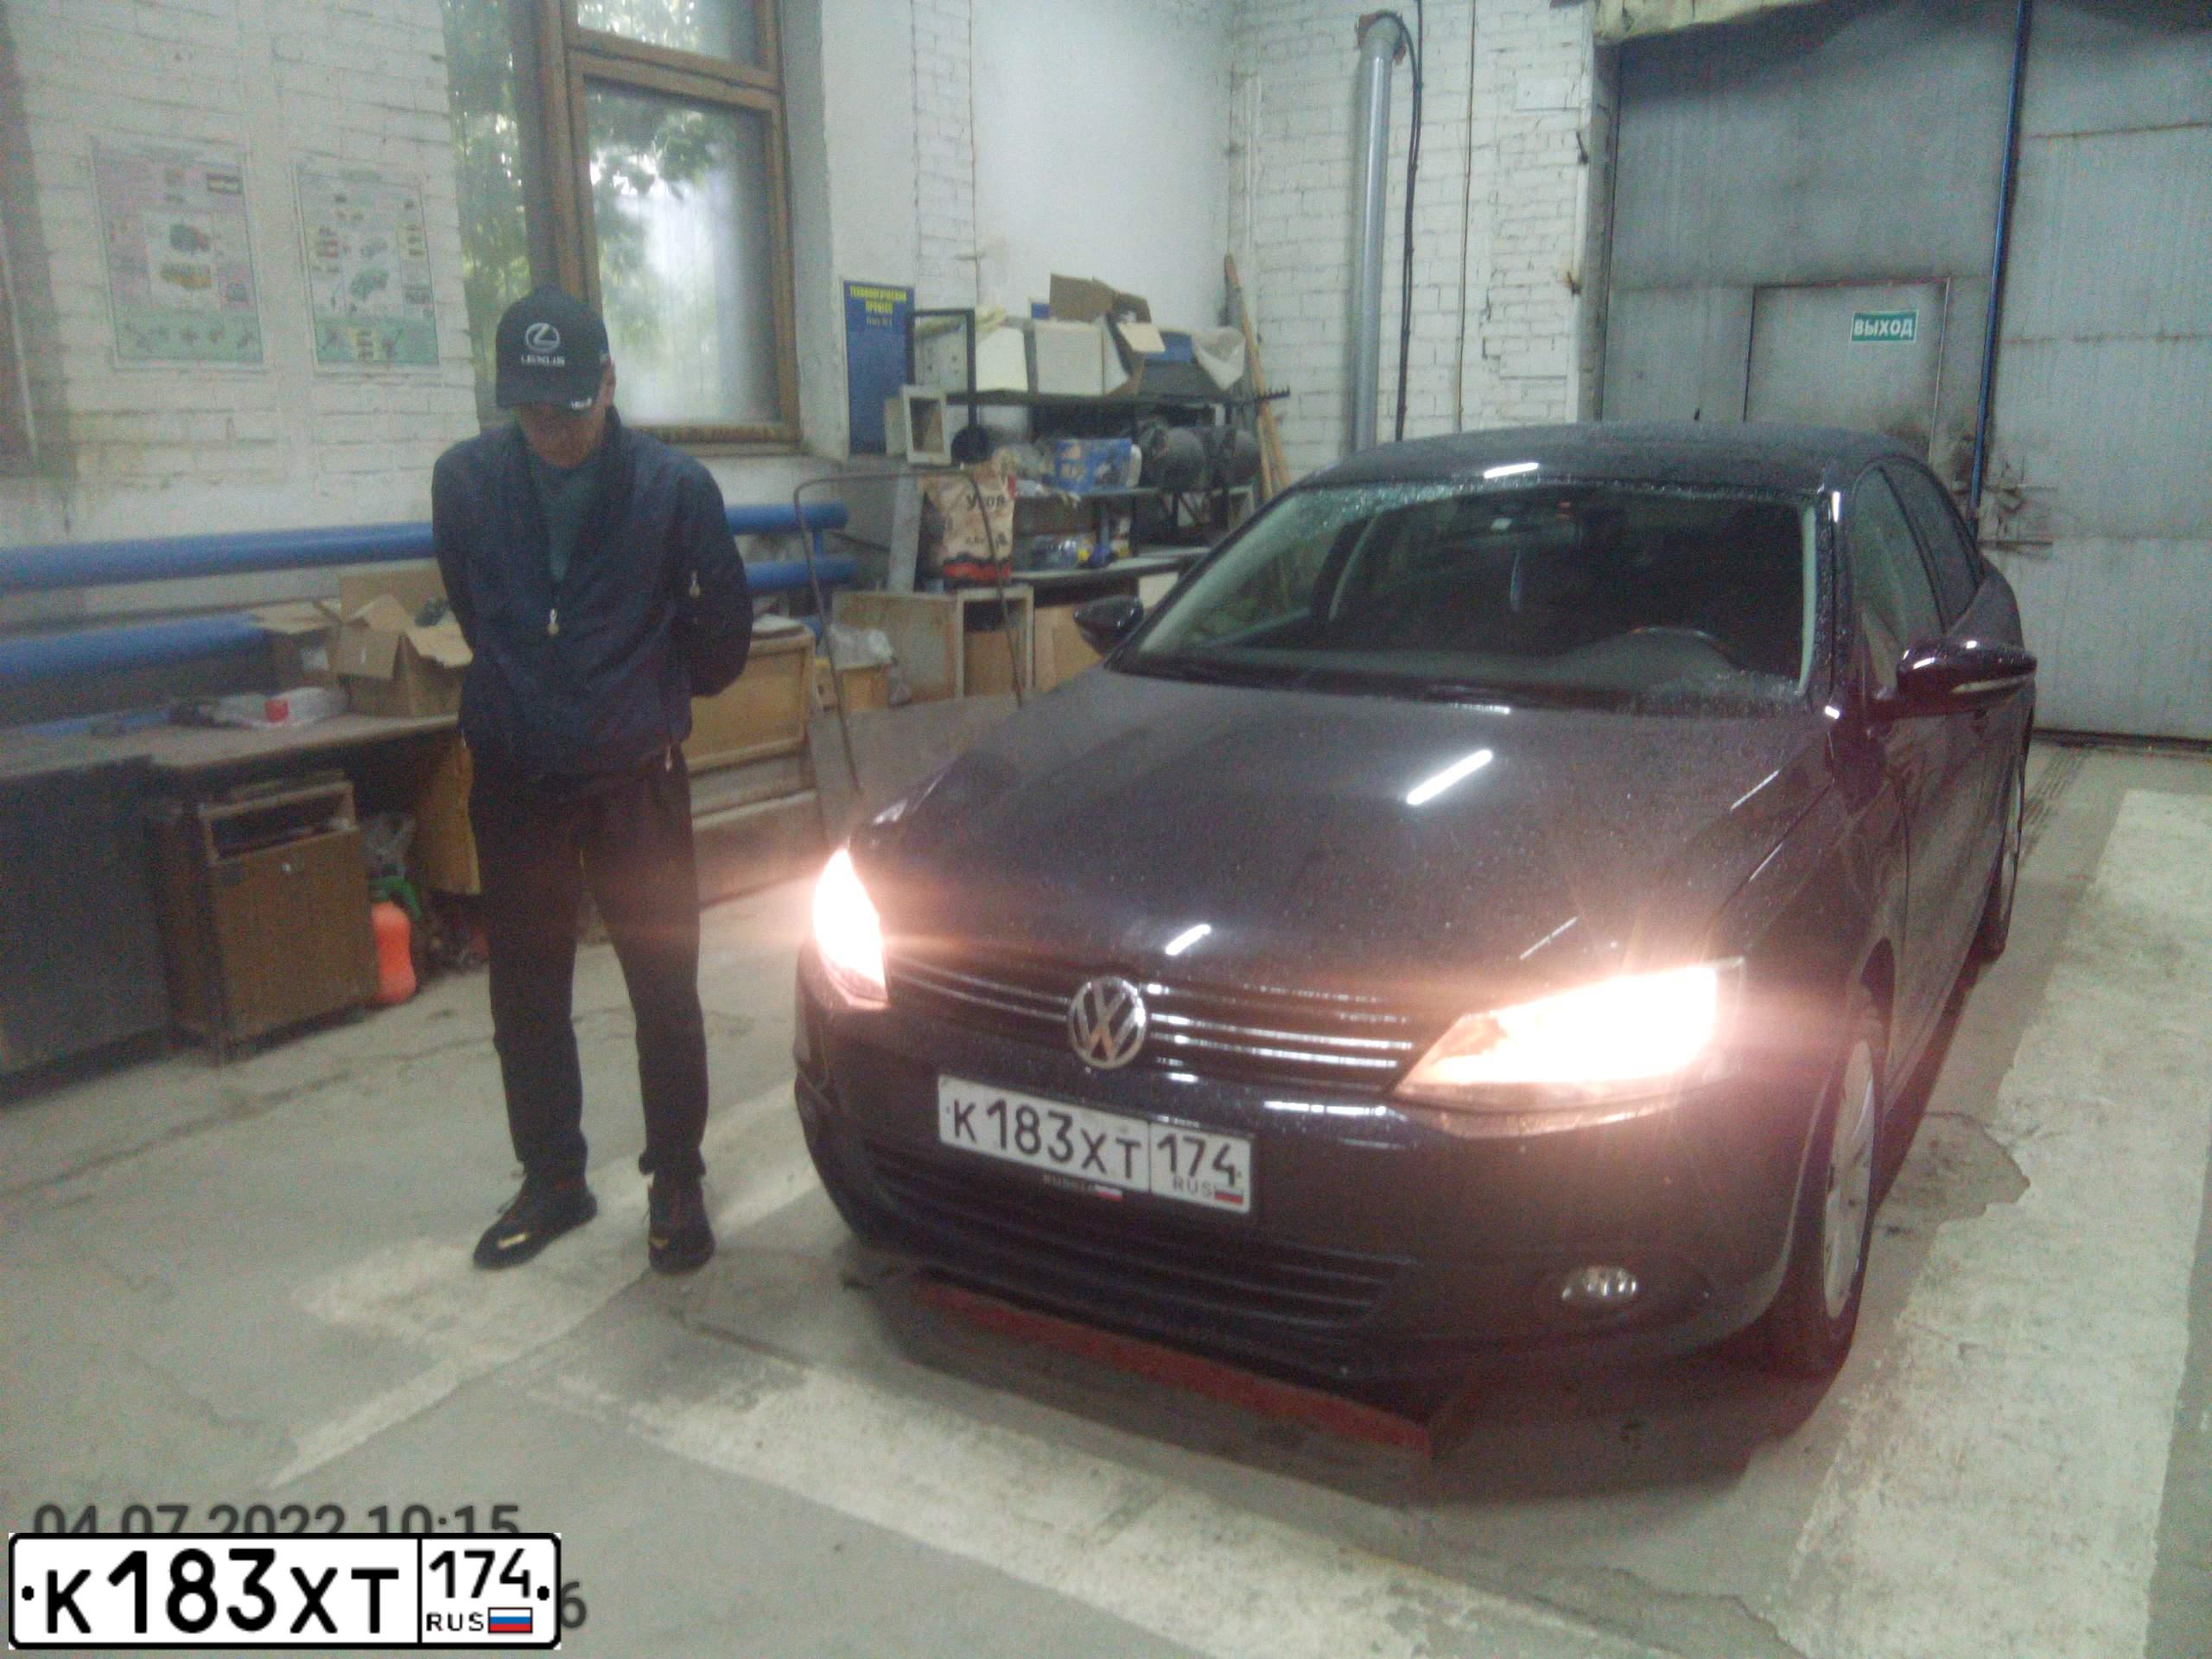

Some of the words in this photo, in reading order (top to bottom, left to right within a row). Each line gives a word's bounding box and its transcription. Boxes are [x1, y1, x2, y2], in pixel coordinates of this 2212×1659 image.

[1853, 317, 1913, 339] ВЫХОД
[953, 1098, 1141, 1179] К183ХТ
[1157, 1133, 1236, 1187] 174
[1173, 1174, 1214, 1197] RUS
